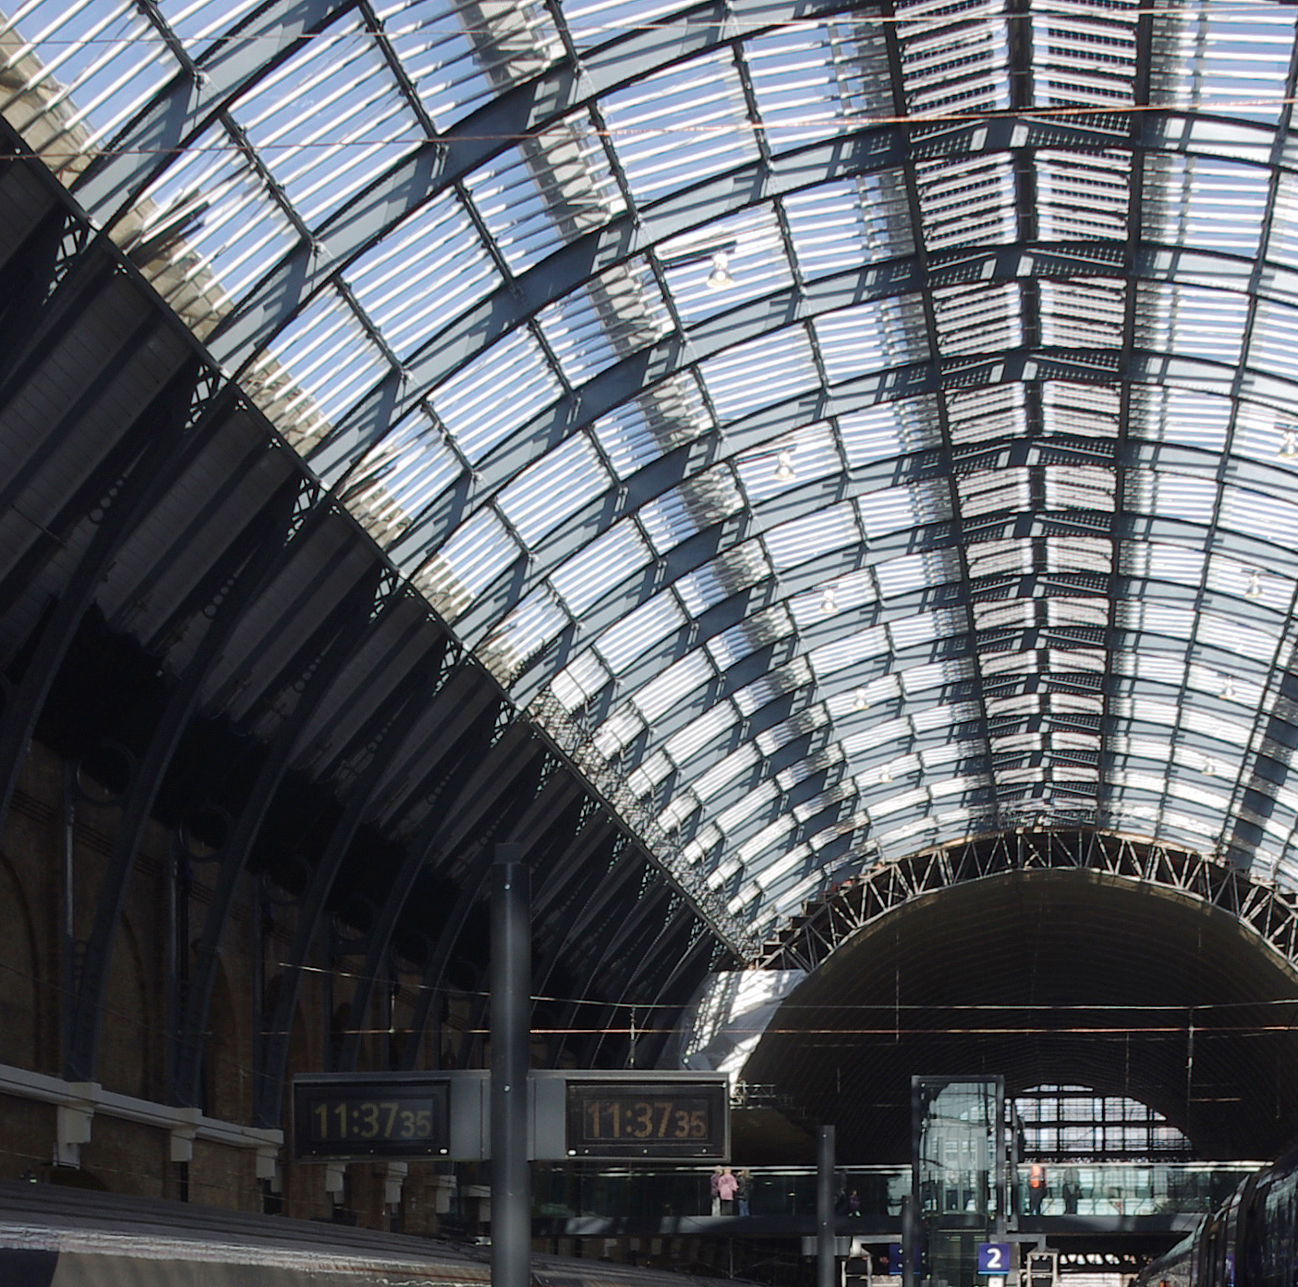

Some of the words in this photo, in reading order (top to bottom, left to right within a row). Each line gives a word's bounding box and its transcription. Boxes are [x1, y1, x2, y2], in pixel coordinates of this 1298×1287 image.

[314, 1102, 400, 1138] 11:37
[400, 1110, 432, 1138] 35
[587, 1101, 674, 1138] 11:37
[987, 1247, 1002, 1269] 2
